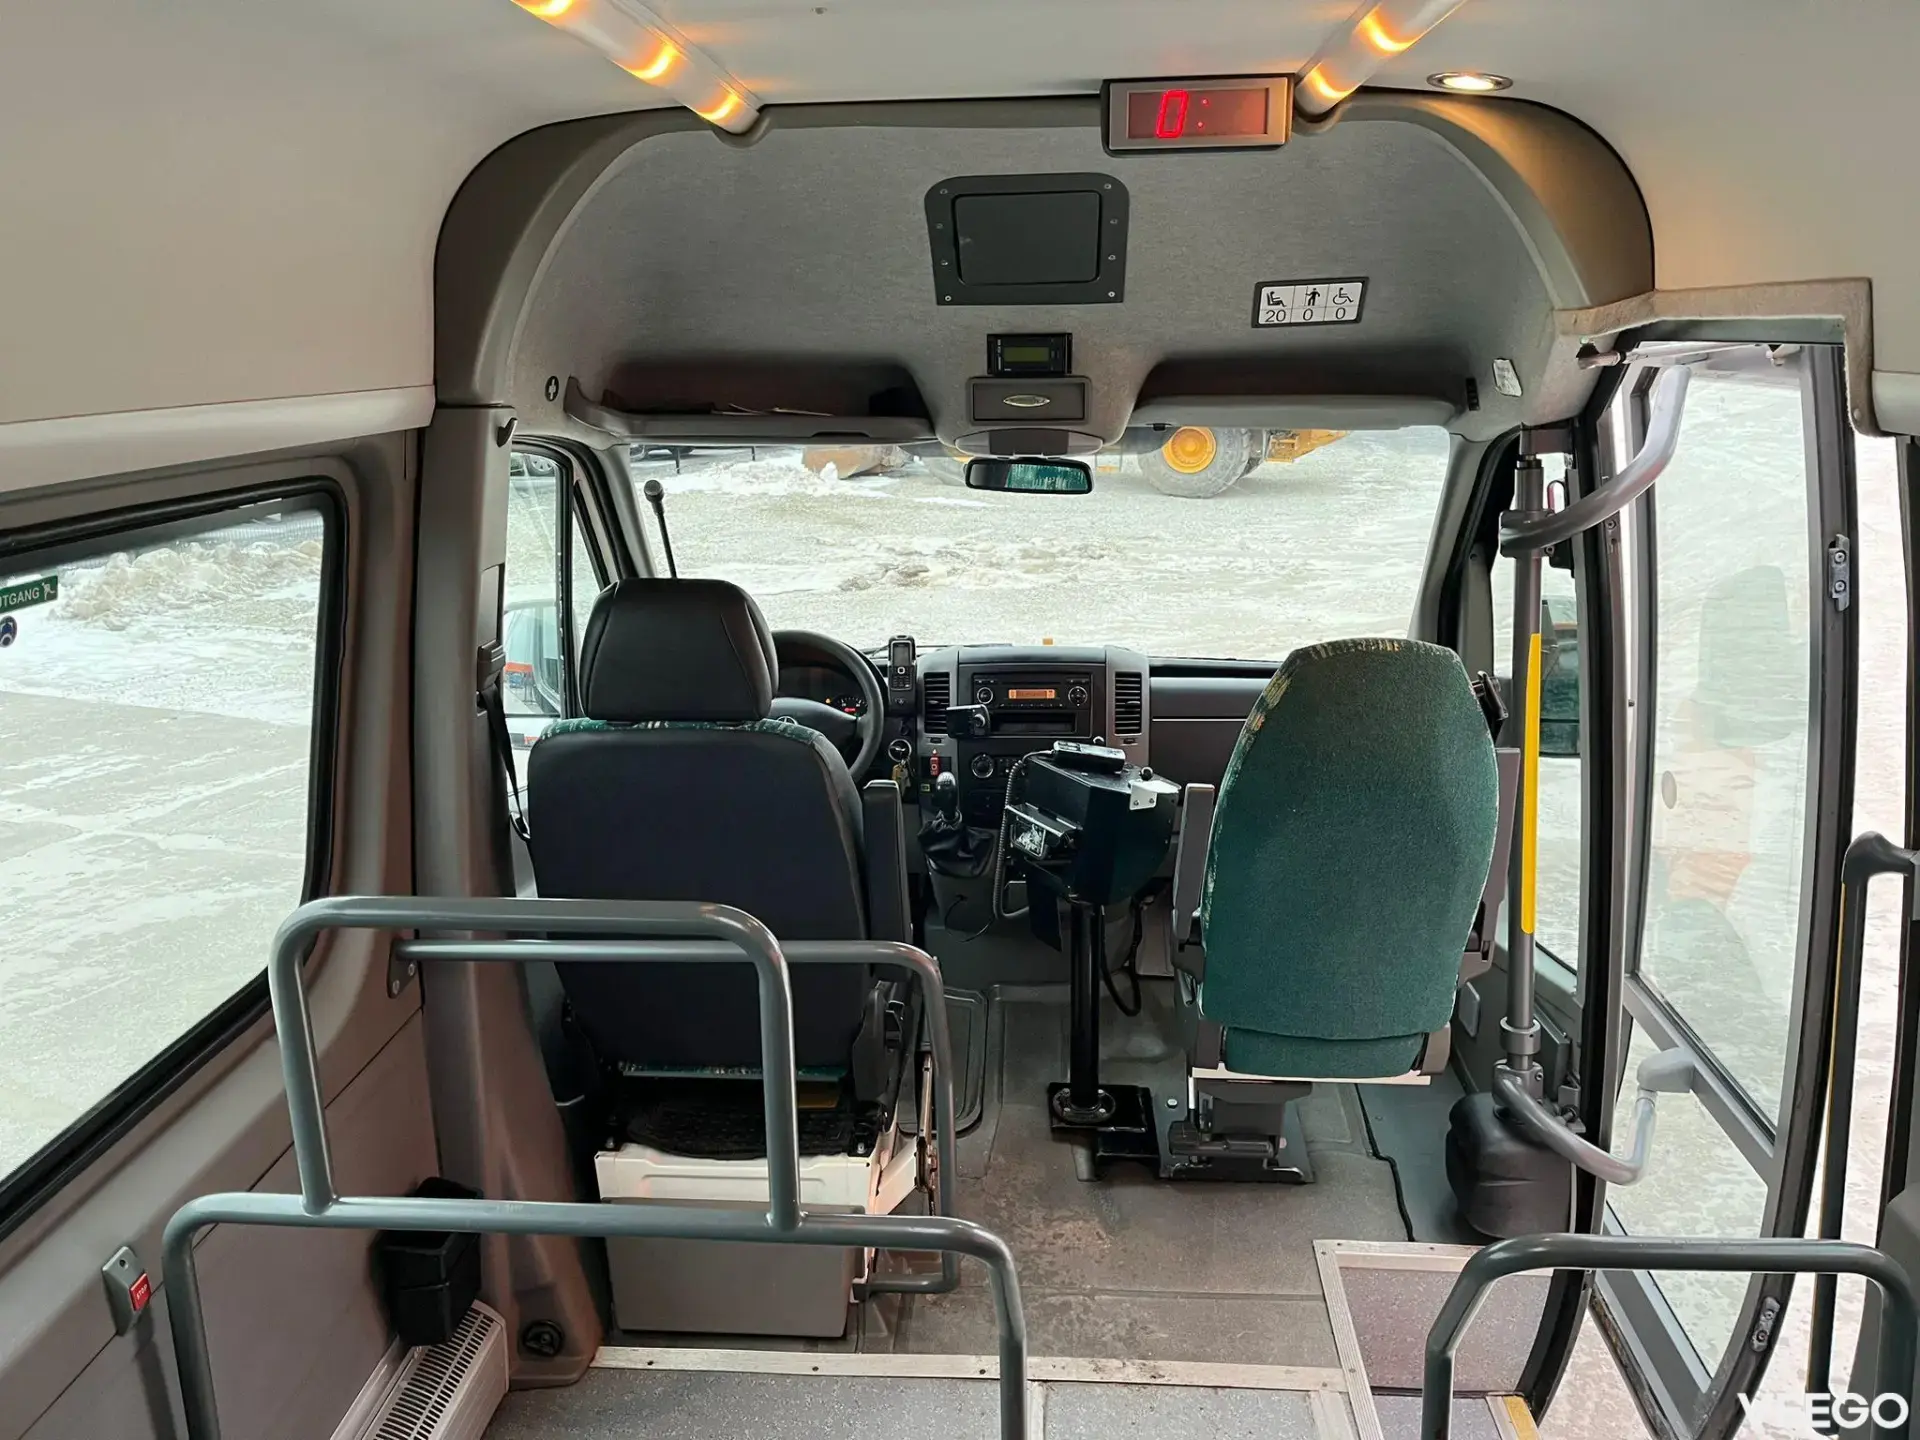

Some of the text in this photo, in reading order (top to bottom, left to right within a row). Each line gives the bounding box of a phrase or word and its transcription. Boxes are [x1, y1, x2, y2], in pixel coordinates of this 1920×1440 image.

[1265, 307, 1346, 323] 20 0 0
[136, 1284, 148, 1300] STOP
